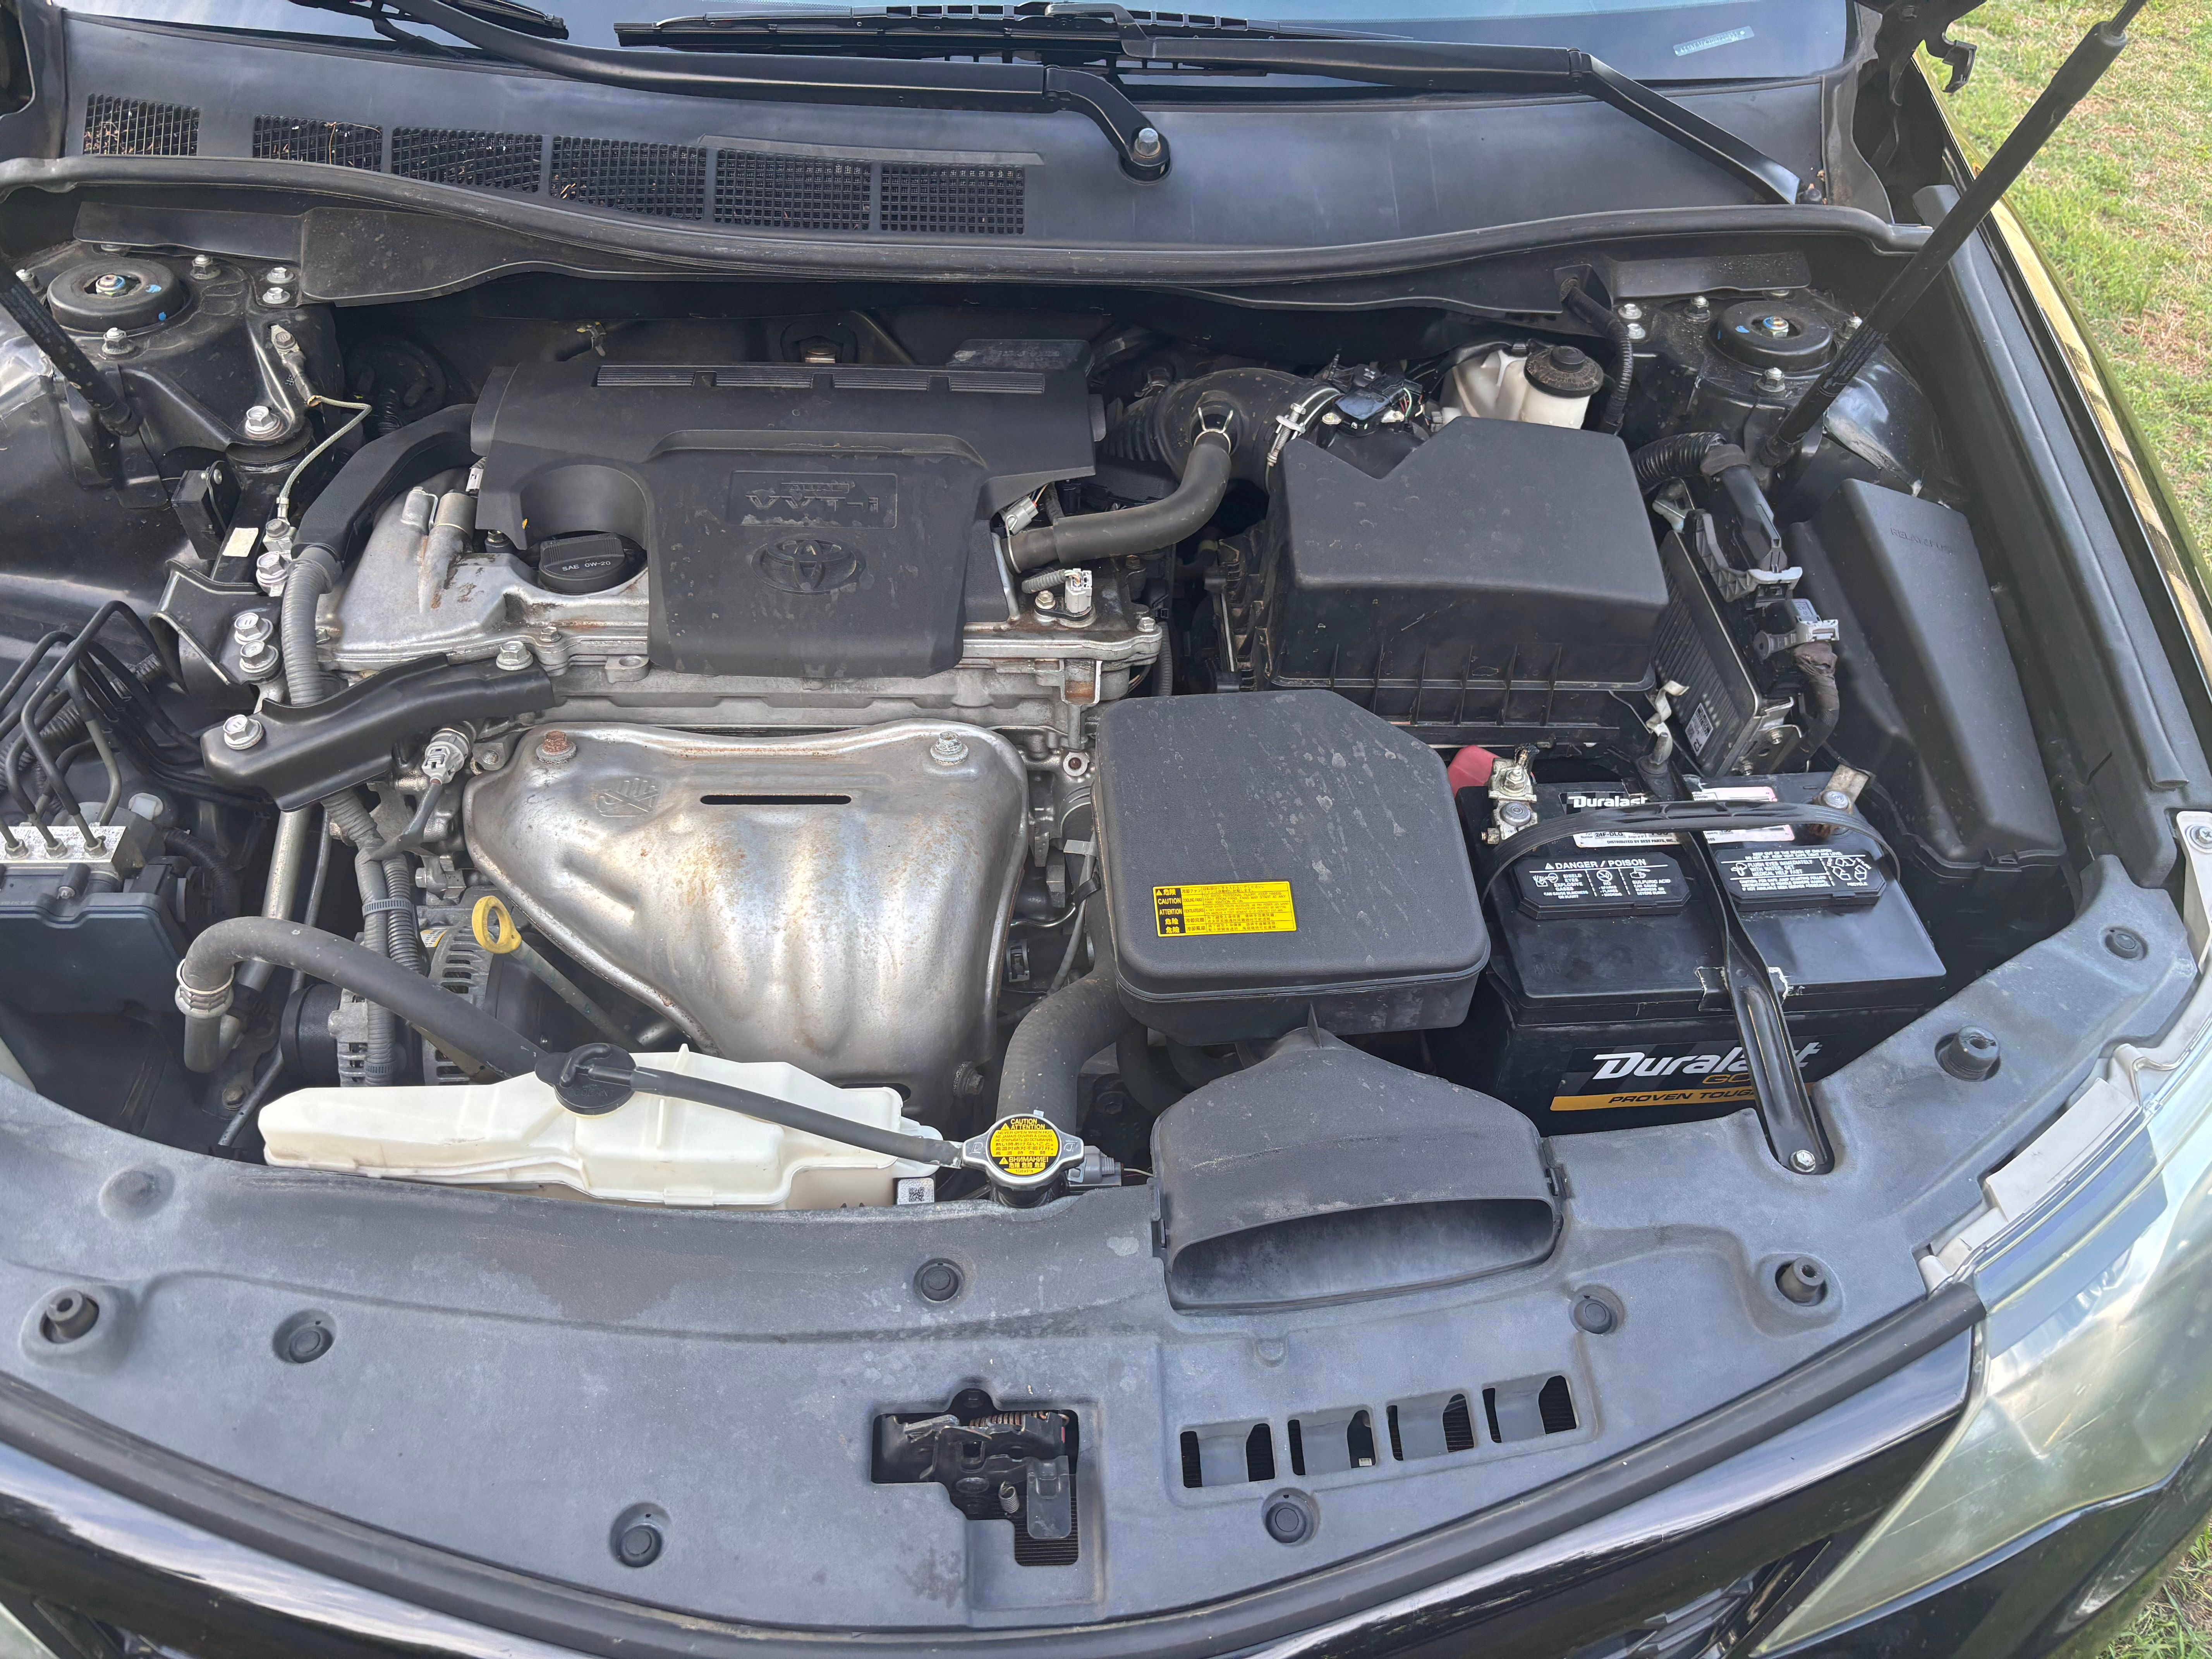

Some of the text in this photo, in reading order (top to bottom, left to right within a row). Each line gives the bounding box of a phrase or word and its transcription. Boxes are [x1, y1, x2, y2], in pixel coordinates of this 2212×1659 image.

[1568, 795, 1648, 808] Duralast
[1555, 861, 1598, 869] DANGER
[1608, 859, 1647, 867] POISON
[1592, 1042, 1820, 1080] Duralat
[1608, 1089, 1755, 1103] PROVEN TOUG
